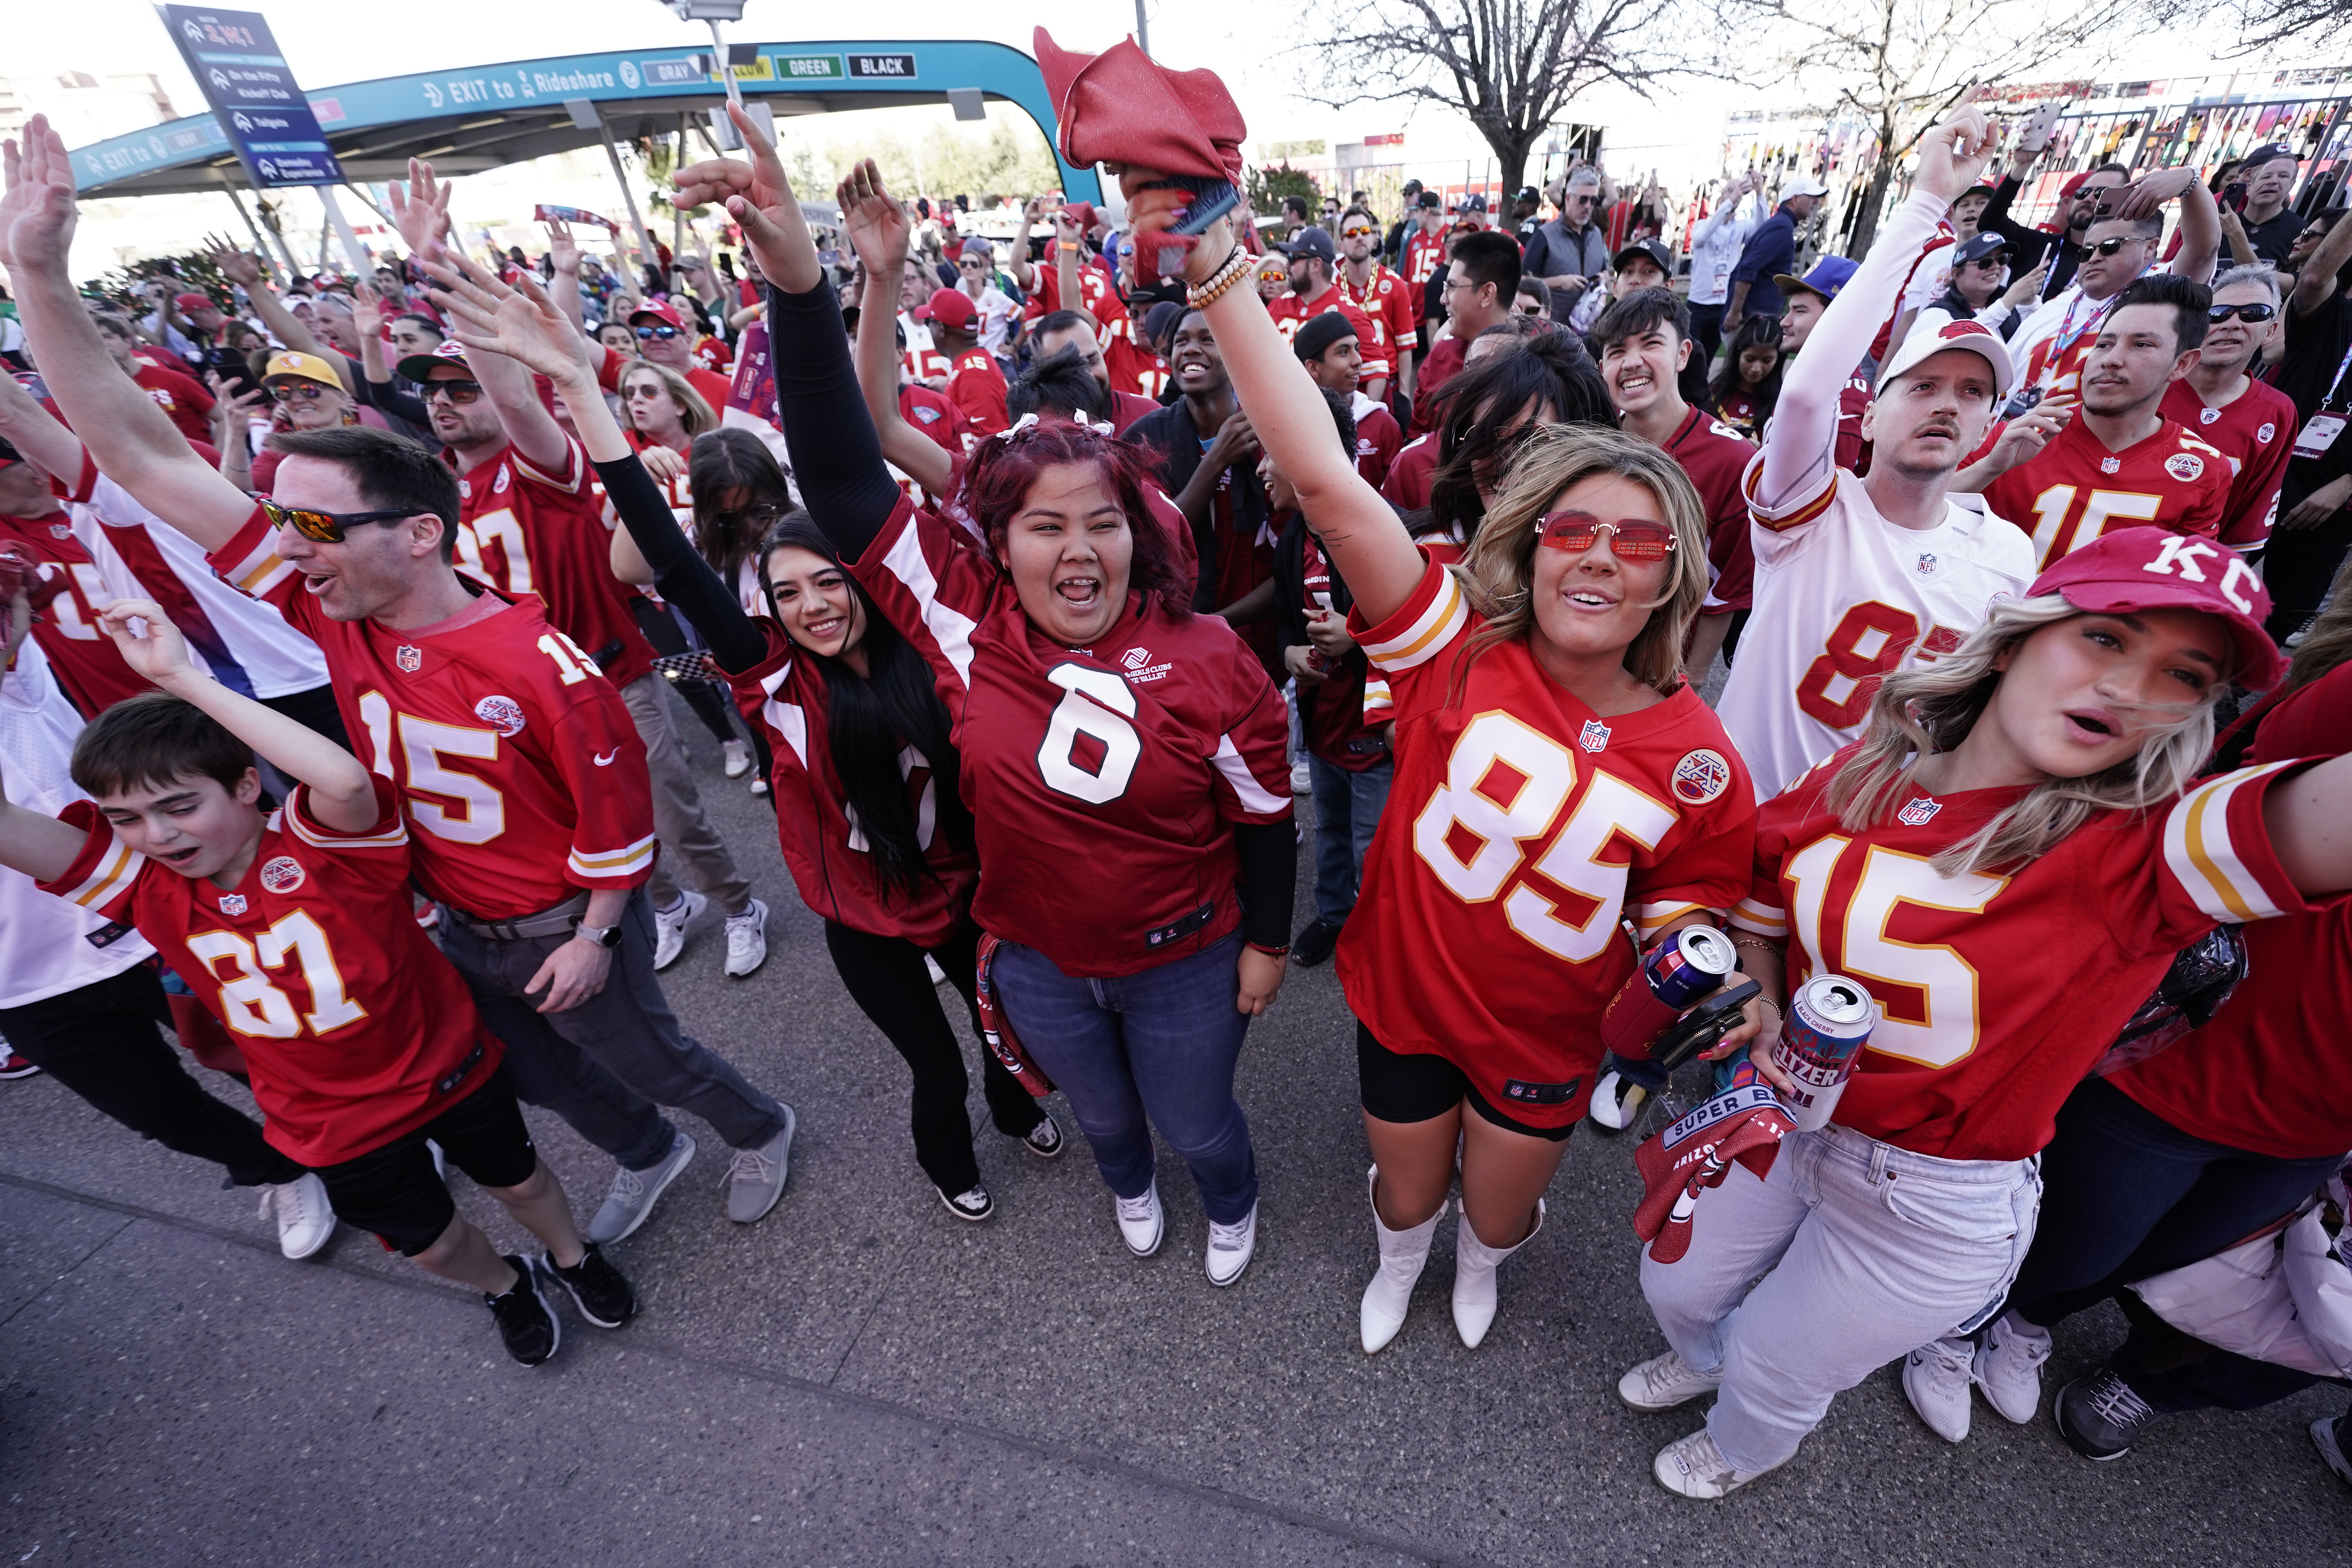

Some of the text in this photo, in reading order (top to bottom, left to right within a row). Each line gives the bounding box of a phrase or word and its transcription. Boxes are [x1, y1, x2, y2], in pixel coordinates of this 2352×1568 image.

[659, 64, 690, 80] GRAY
[789, 58, 831, 75] GREEN
[861, 57, 905, 75] BLACK
[448, 70, 615, 104] EXIT to Rideshare
[252, 116, 290, 129] Tailgate
[102, 147, 152, 171] EXIT to
[1412, 249, 1440, 283] 15
[963, 356, 988, 370] 15
[2031, 484, 2163, 575] 15
[1920, 562, 1934, 572] NFL
[1304, 575, 1330, 586] CARDIN
[400, 655, 419, 669] NFL
[537, 632, 603, 686] 15
[1149, 663, 1172, 673] CLUBS
[1139, 672, 1167, 682] VALLEY
[1035, 661, 1143, 806] 6
[1583, 732, 1603, 748] NFL
[359, 690, 505, 844] 15
[1903, 807, 1927, 821] NFL
[1413, 708, 1680, 964] 85
[225, 903, 243, 912] NFL
[1783, 833, 2013, 1070] 15
[185, 907, 369, 1038] 87
[1798, 1006, 1834, 1034] BLACK CHERRY
[1774, 1036, 1839, 1086] ELTZER
[1793, 1046, 1843, 1069] LIGHT
[1675, 1097, 1740, 1136] SUPER
